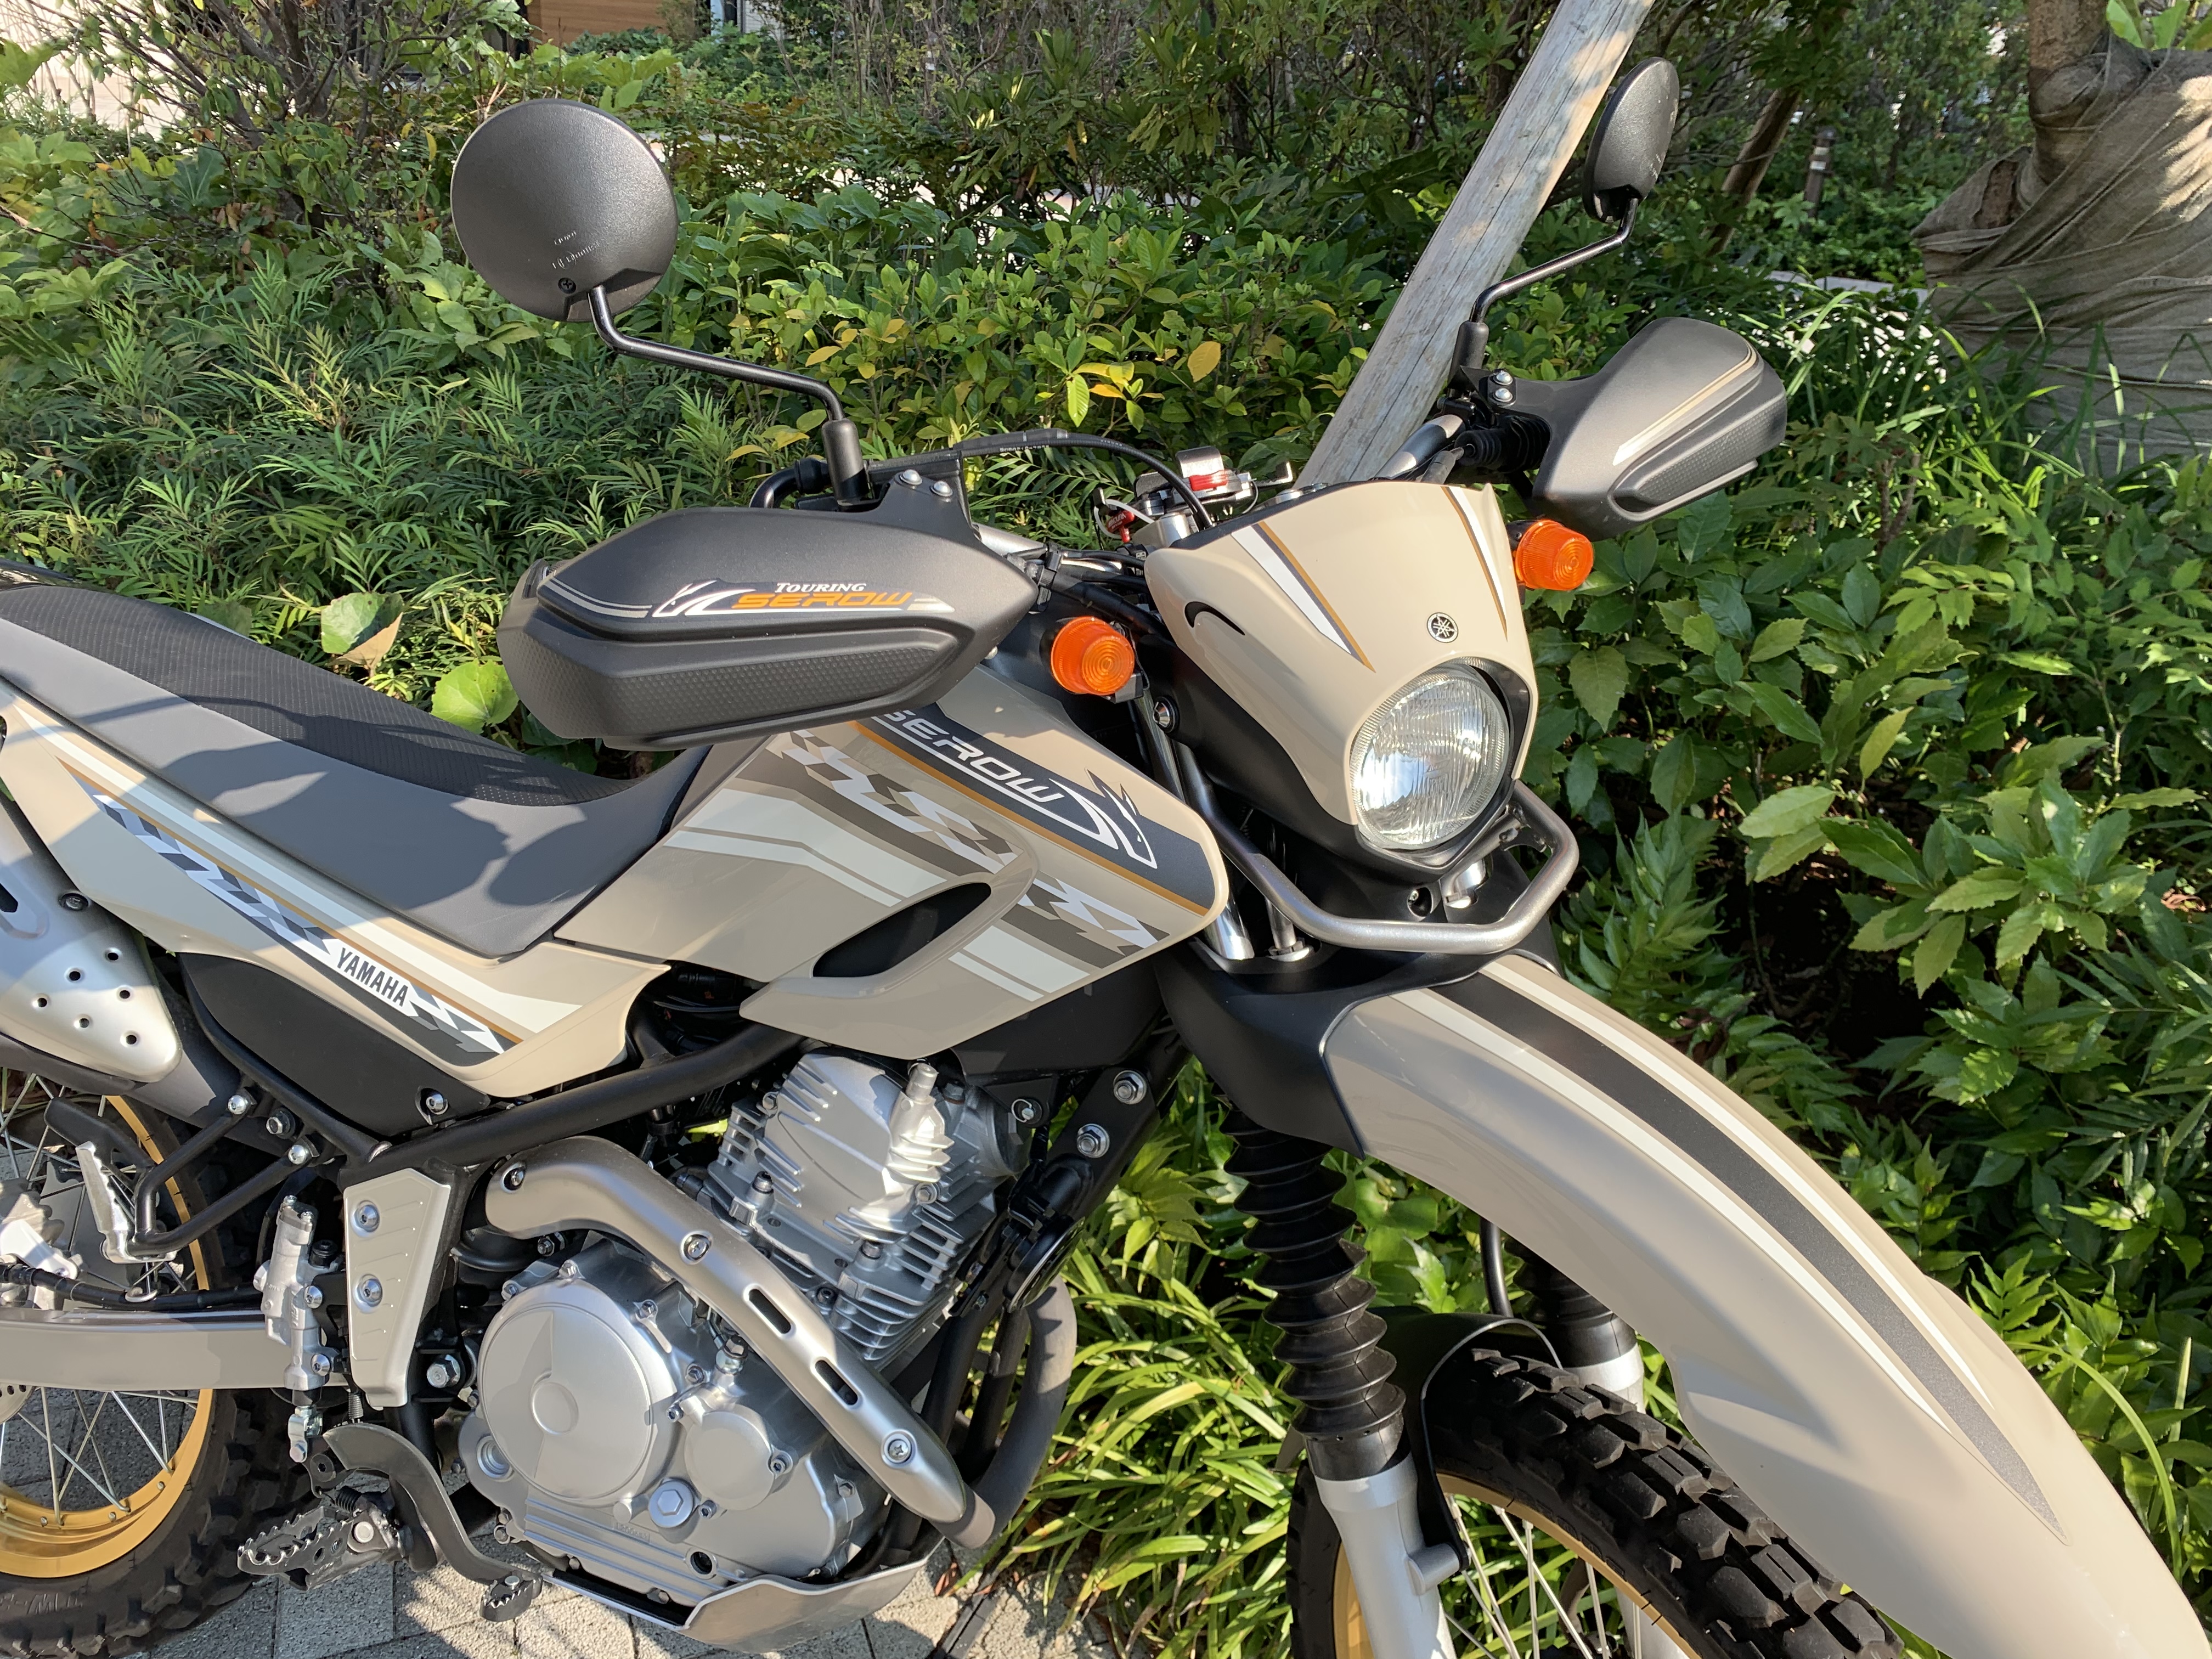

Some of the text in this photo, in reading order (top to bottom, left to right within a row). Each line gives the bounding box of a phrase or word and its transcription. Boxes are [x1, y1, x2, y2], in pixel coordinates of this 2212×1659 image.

[775, 583, 867, 592] TOURING
[731, 592, 912, 608] SEROW
[337, 947, 408, 1007] YAMAHA
